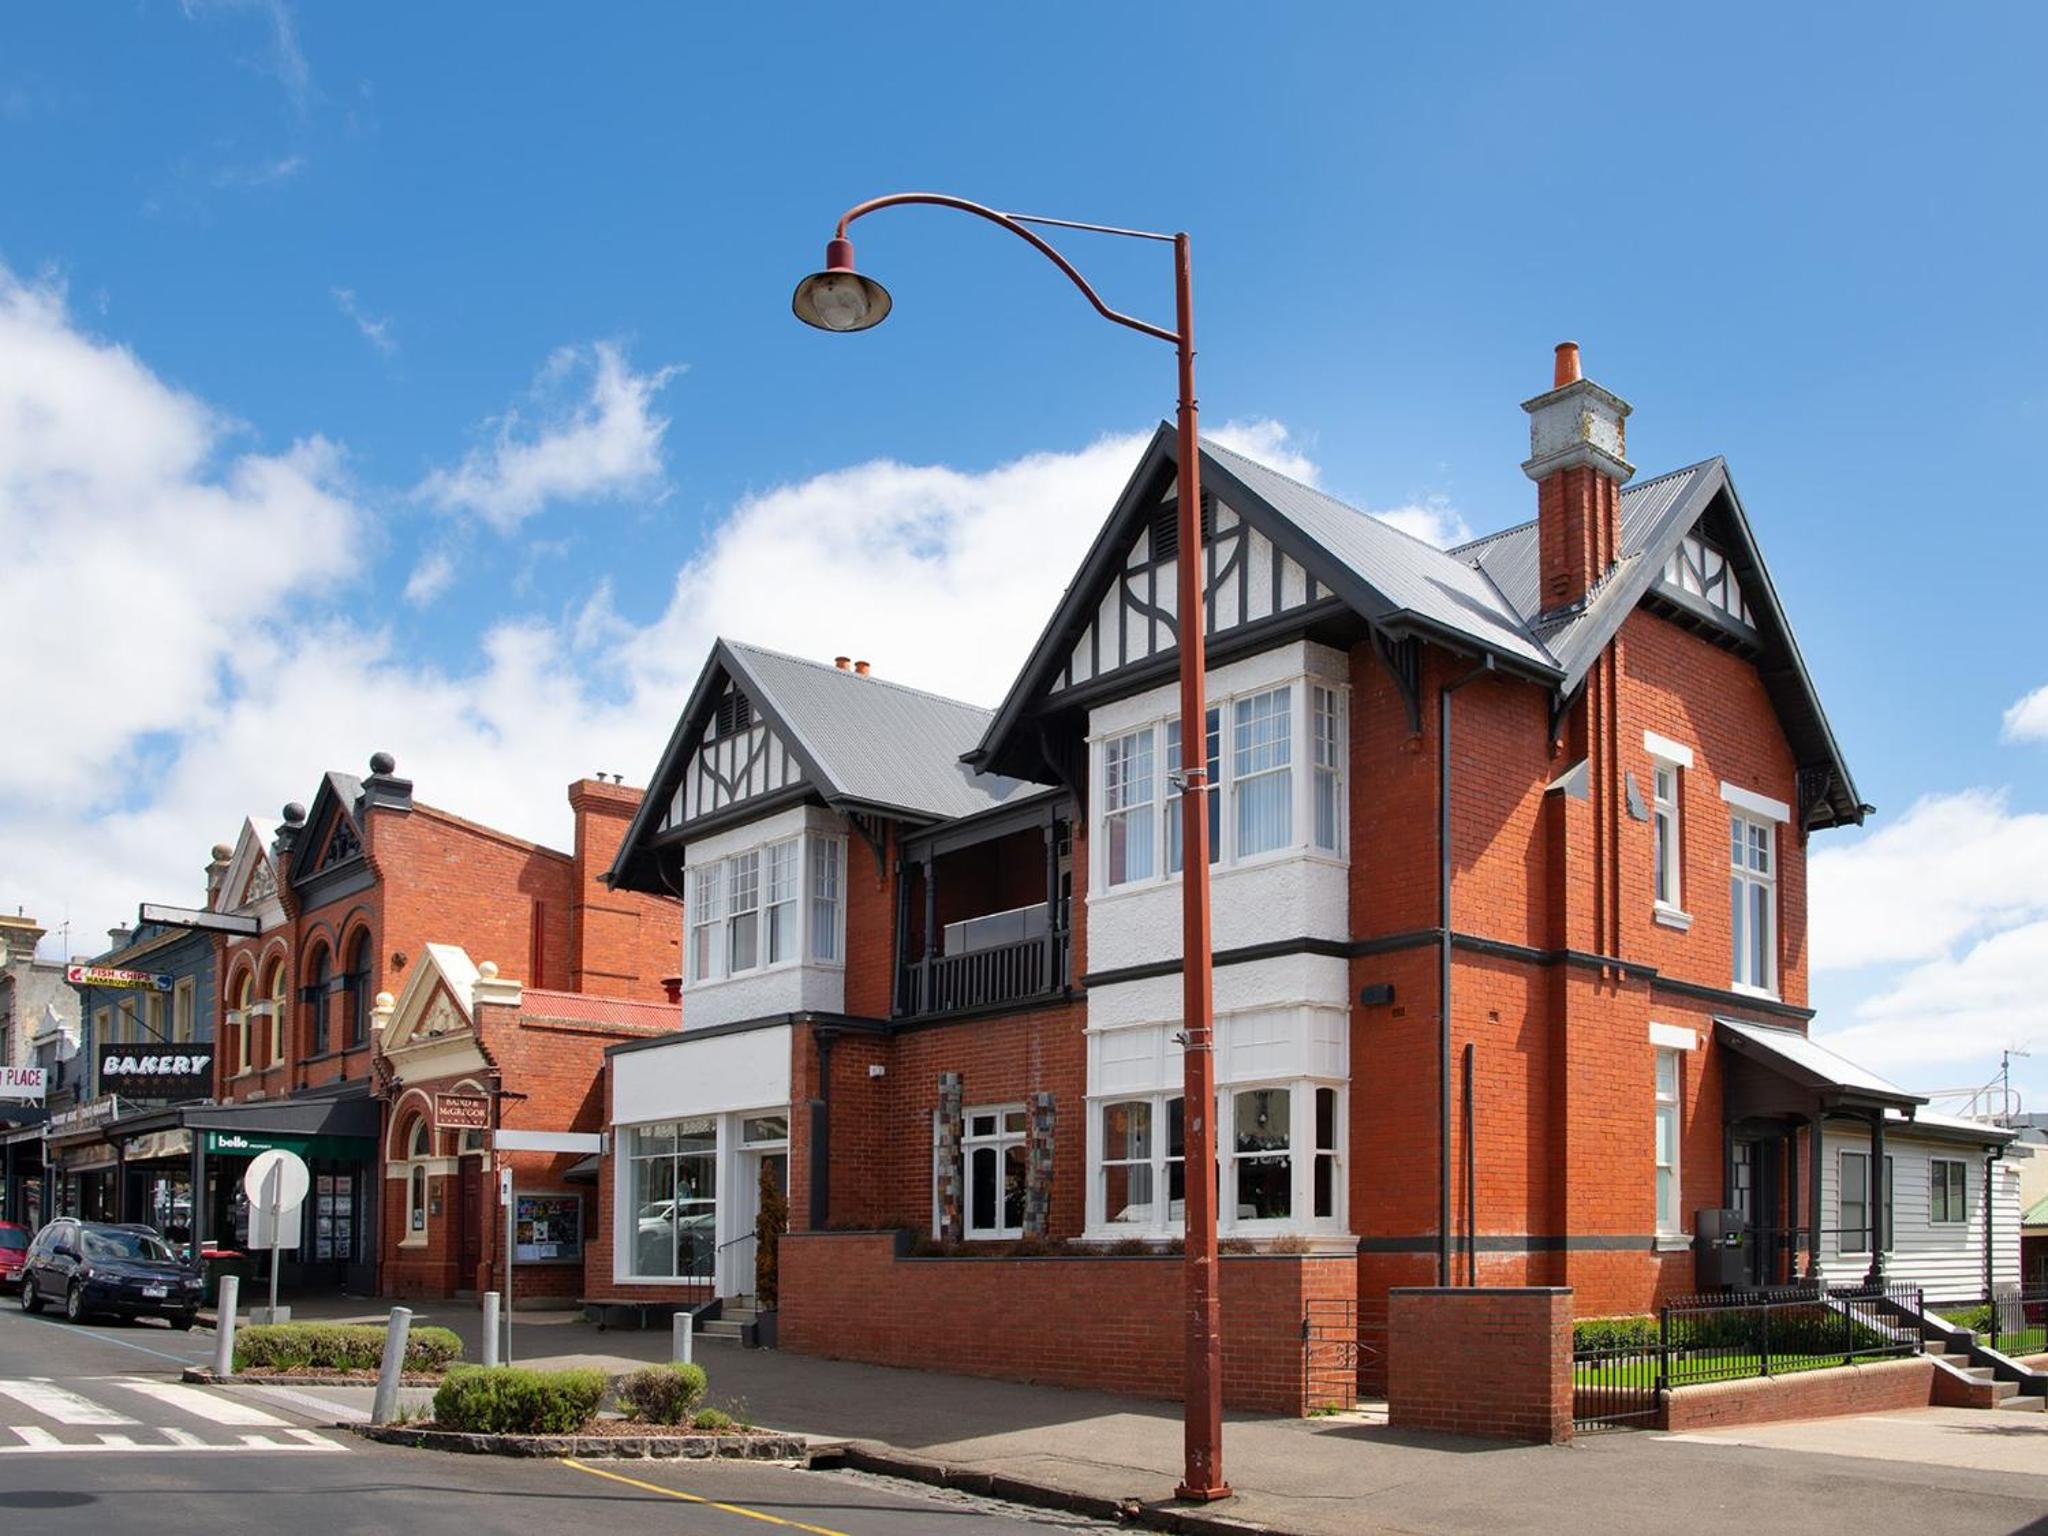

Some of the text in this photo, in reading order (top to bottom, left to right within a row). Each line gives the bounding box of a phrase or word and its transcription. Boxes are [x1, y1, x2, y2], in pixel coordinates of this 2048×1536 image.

[91, 967, 151, 980] FISH CHIPS
[86, 976, 154, 988] HAMBURGERS
[103, 1055, 212, 1075] BAKERY
[7, 1069, 41, 1086] PLACE
